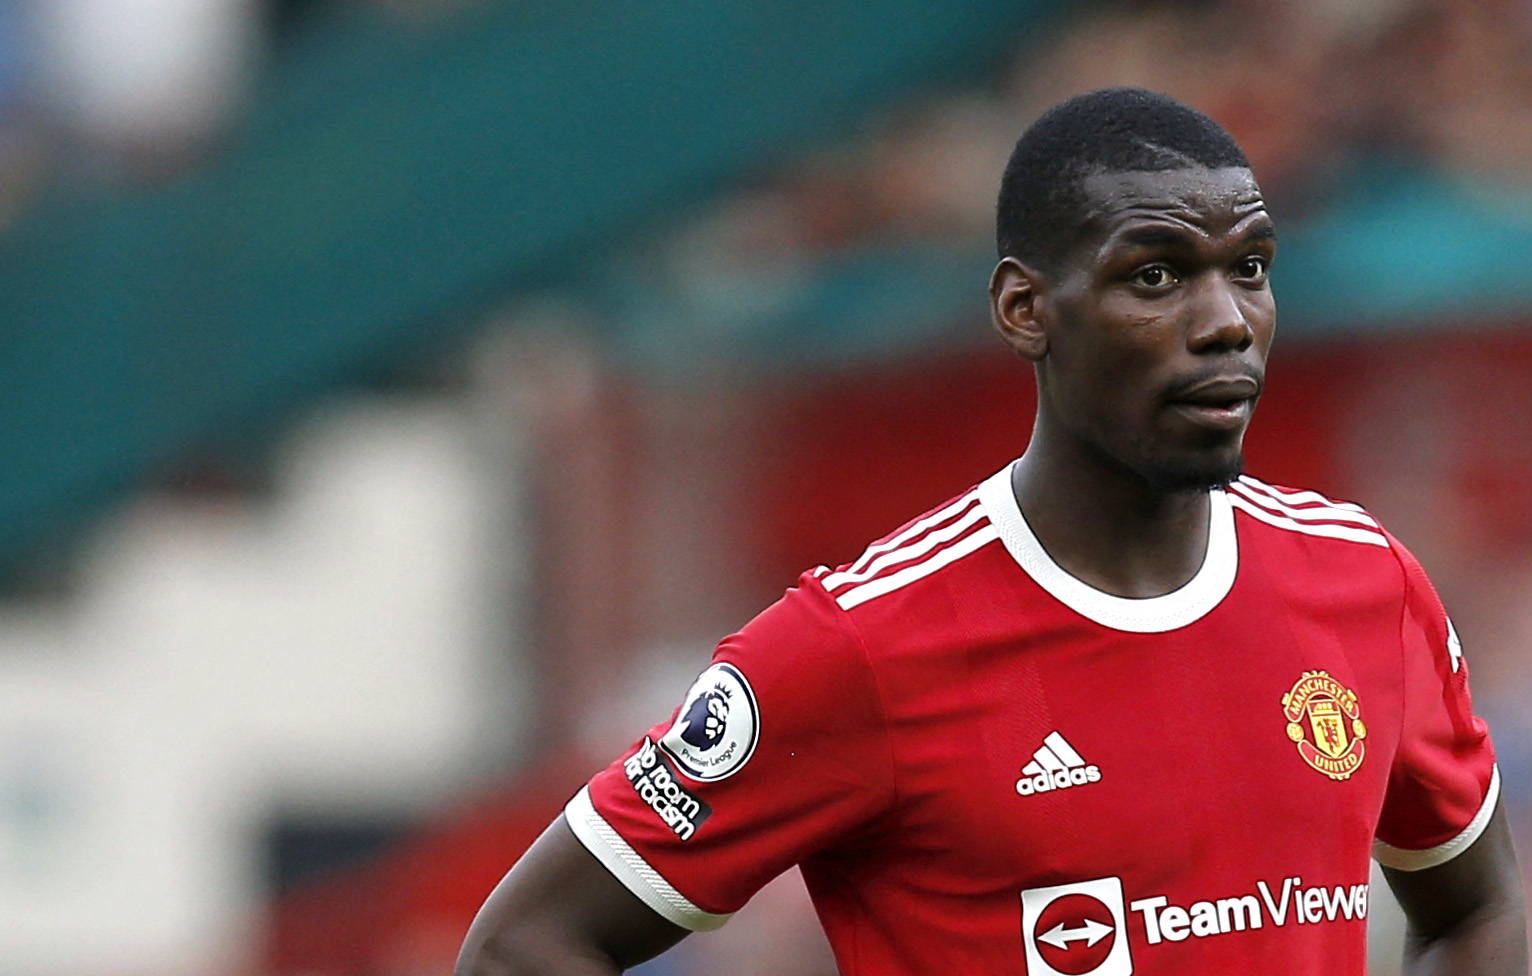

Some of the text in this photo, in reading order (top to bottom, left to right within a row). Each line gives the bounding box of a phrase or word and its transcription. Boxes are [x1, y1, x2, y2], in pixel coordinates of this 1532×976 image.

[1290, 679, 1354, 716] MANCHESTER
[709, 741, 737, 766] League
[1315, 753, 1357, 772] UNITED
[649, 764, 700, 820] room
[1016, 764, 1101, 796] adidas
[634, 775, 696, 841] racism
[1131, 877, 1369, 944] TeamViewe
